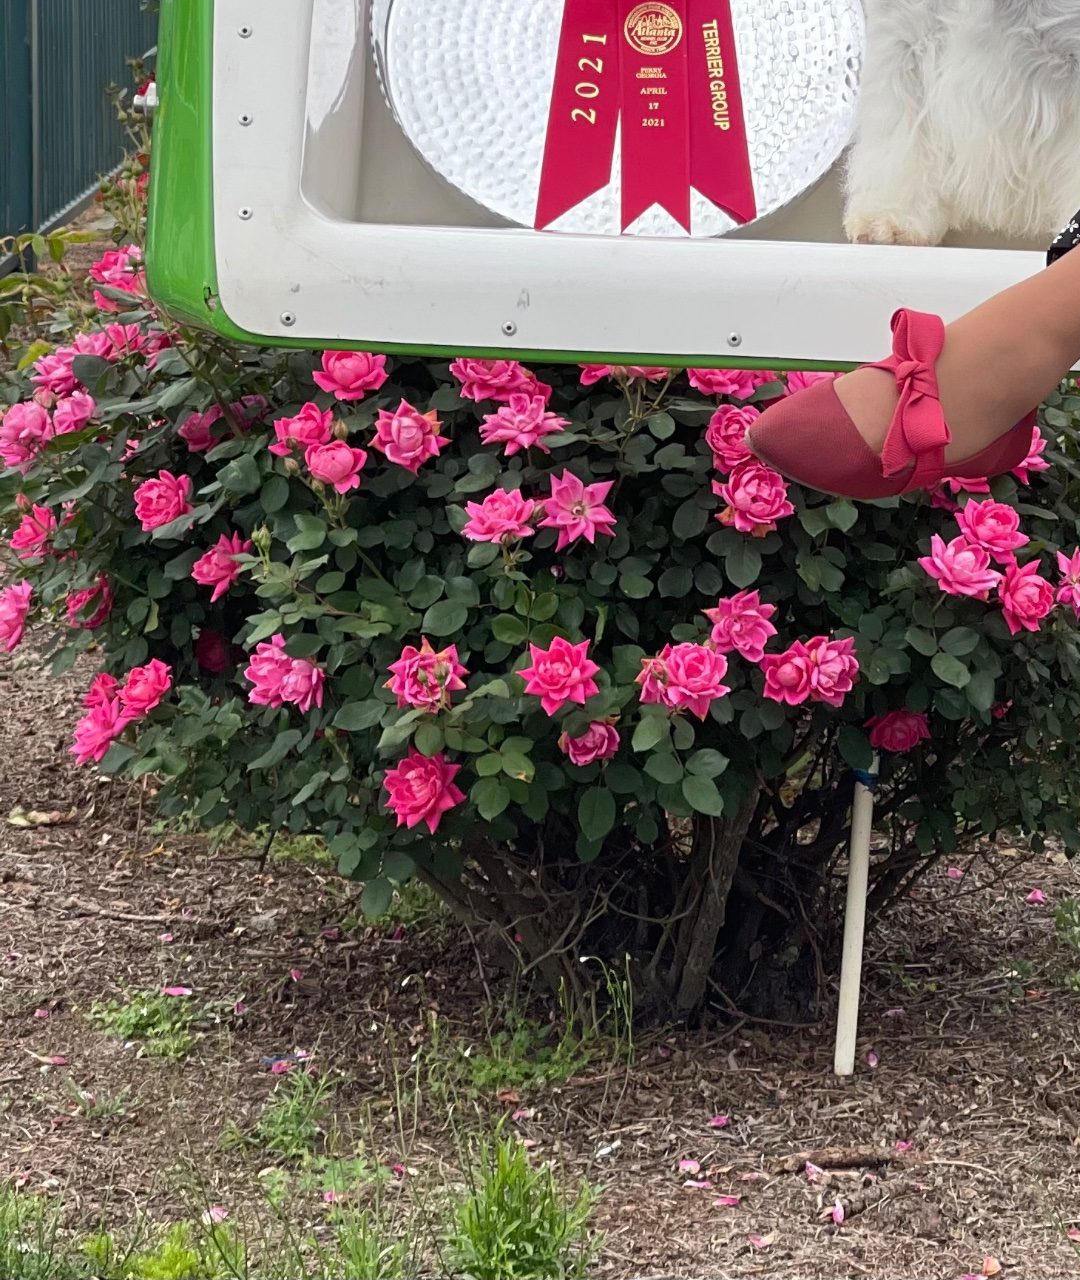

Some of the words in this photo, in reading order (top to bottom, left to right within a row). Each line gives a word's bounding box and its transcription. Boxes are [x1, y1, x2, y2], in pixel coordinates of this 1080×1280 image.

[631, 19, 676, 37] Atlanta
[702, 19, 724, 79] TERRIER
[571, 33, 607, 125] 2021
[640, 87, 668, 95] APRIL
[648, 102, 659, 110] 17
[709, 79, 730, 131] GROUP
[641, 118, 665, 127] 2021
